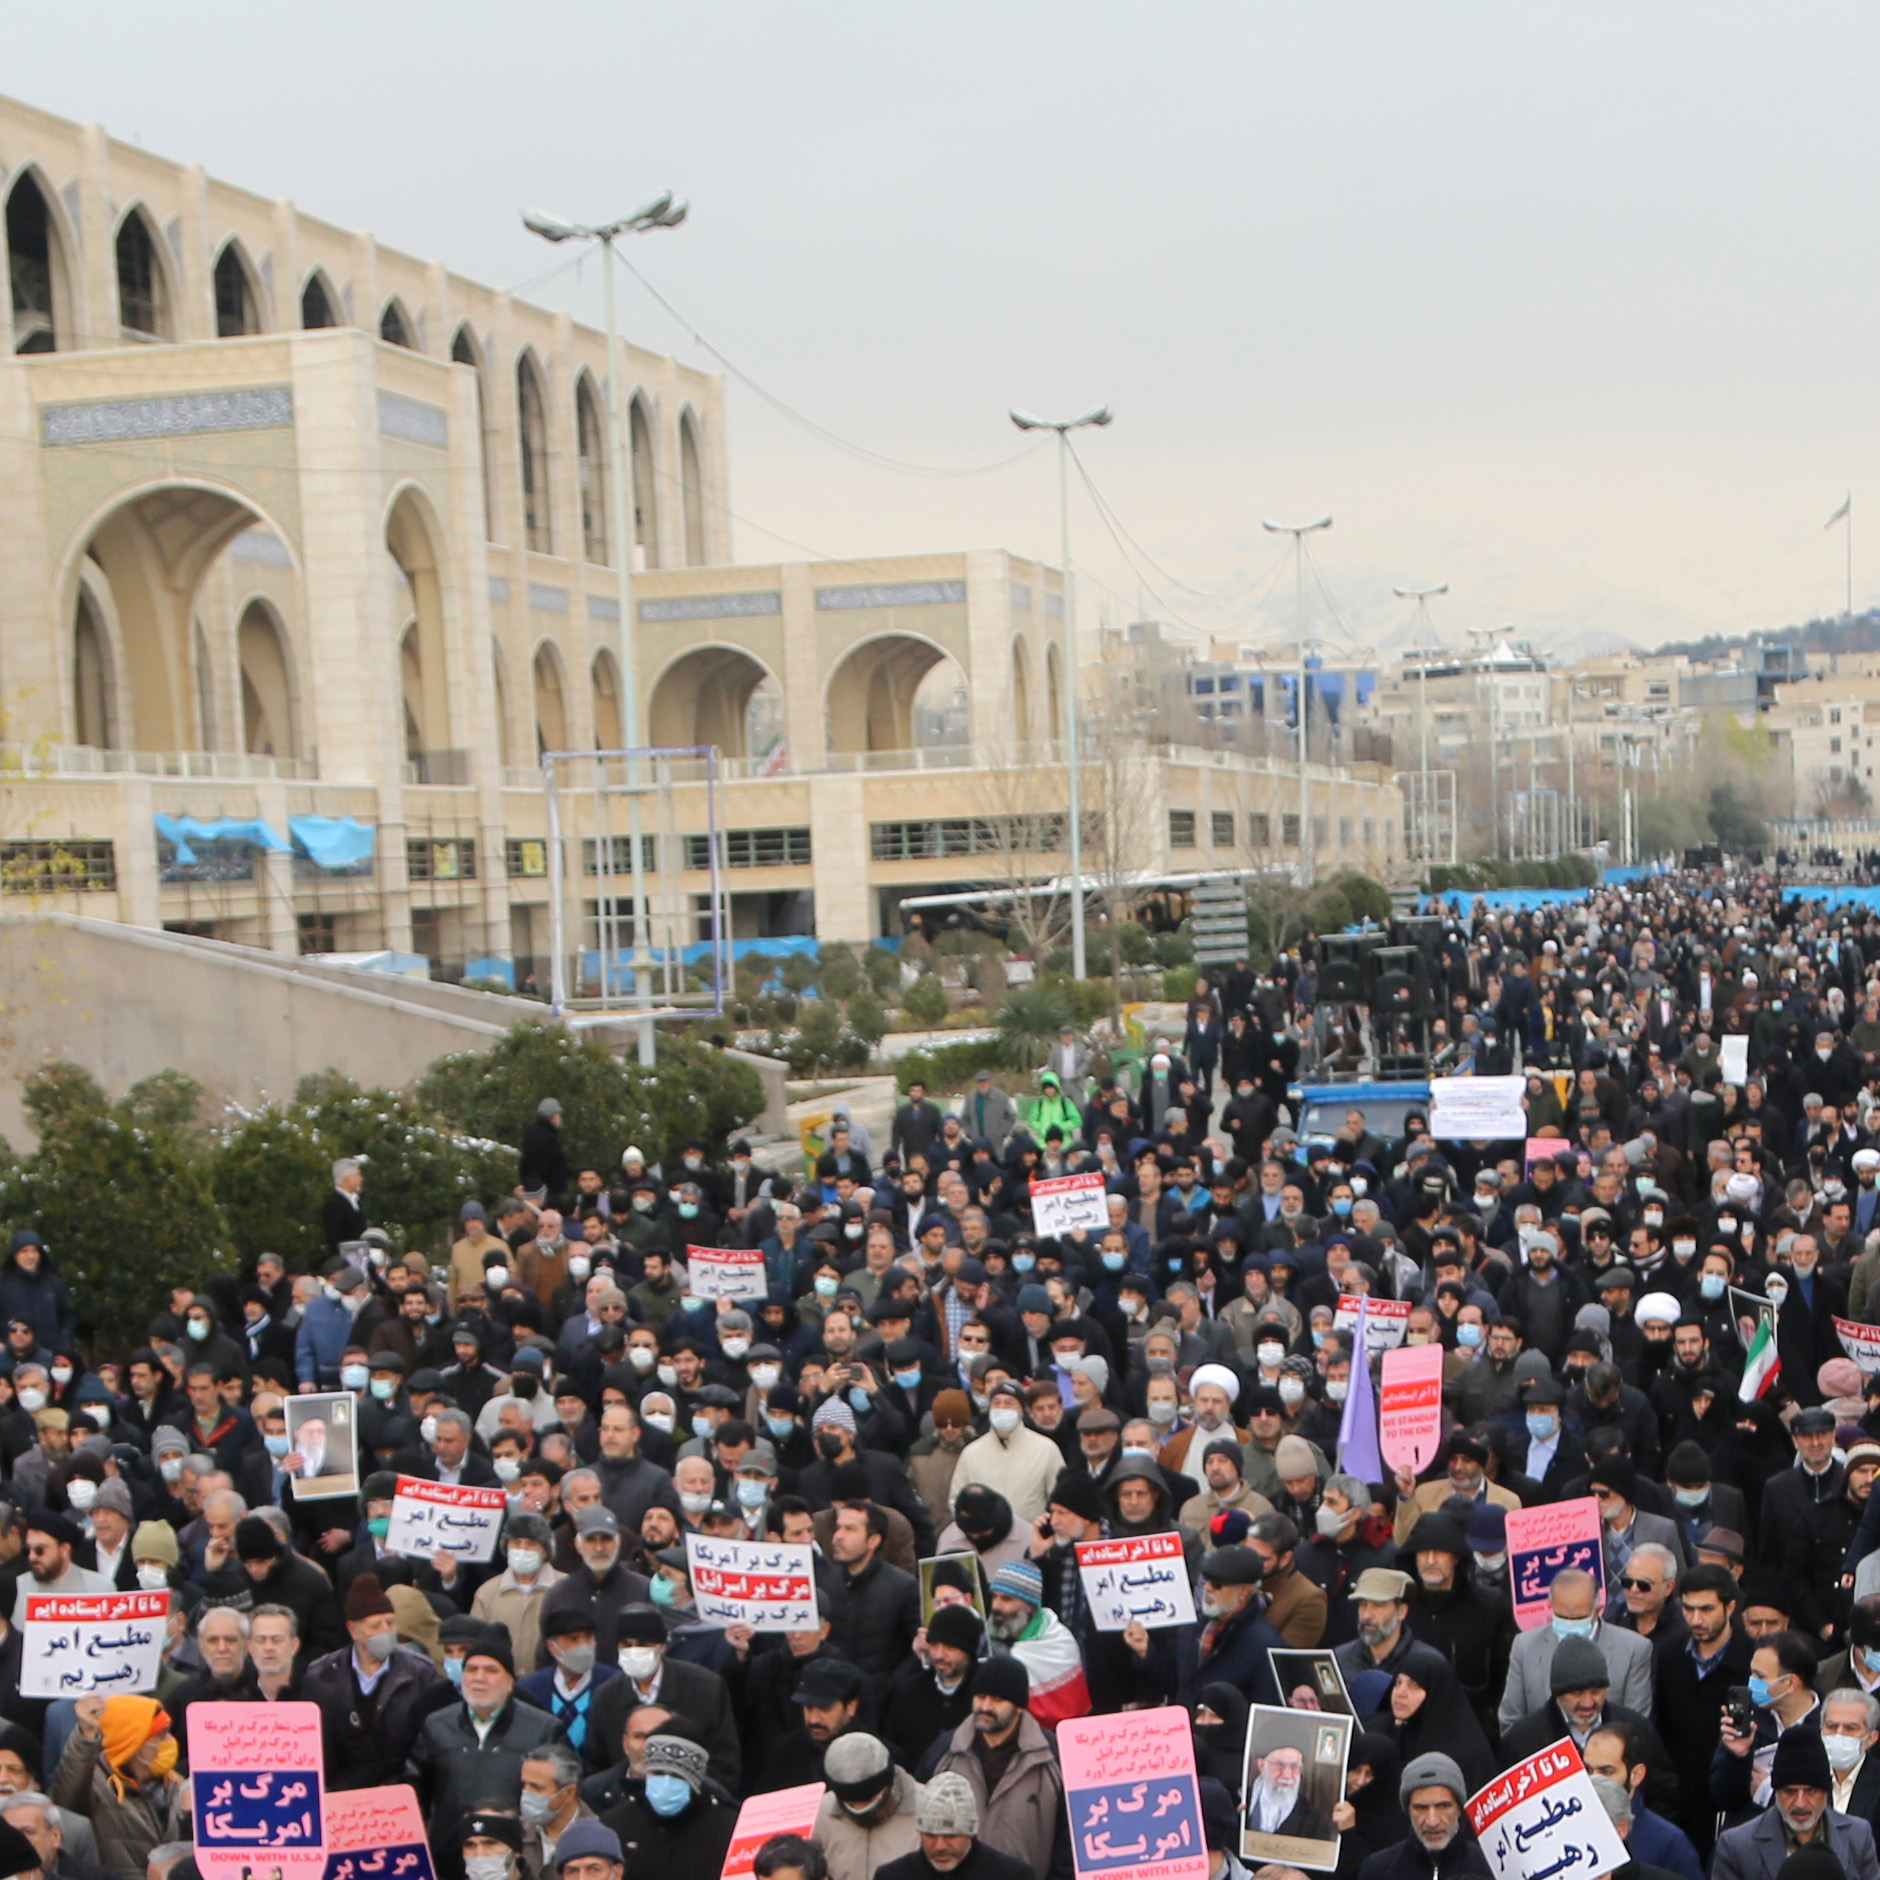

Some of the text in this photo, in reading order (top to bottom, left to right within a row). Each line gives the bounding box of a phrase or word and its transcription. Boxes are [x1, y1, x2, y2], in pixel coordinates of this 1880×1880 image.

[40, 1624, 152, 1657] مطیع امر
[59, 1663, 140, 1690] رهبریم
[206, 1771, 307, 1807] مرگ بر
[1083, 1782, 1183, 1828] مرگ بر
[210, 1852, 322, 1863] DOWN WITH U.S.A
[1136, 1865, 1170, 1879] WITH
[1173, 1860, 1205, 1874] U.S.A
